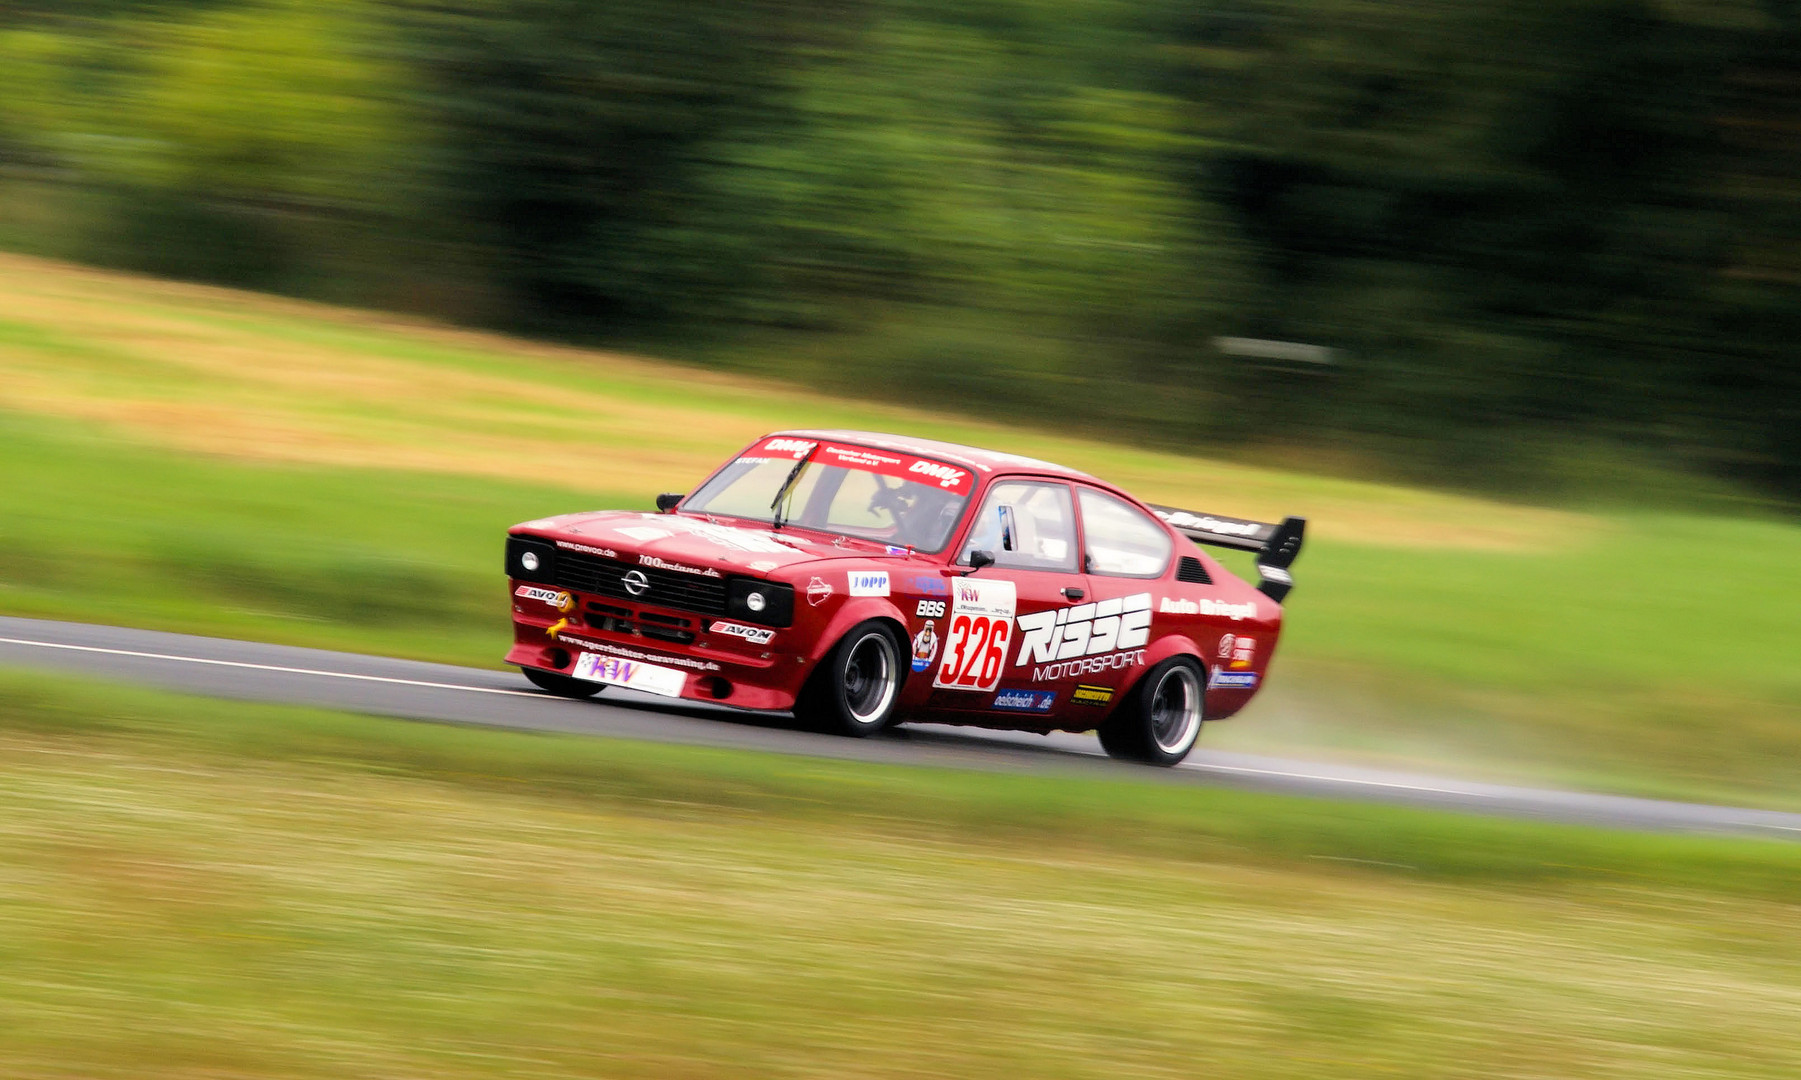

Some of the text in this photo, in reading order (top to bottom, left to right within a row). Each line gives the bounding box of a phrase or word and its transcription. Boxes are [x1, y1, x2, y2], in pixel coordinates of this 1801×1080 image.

[764, 439, 818, 452] DMV
[909, 460, 965, 480] DMV
[854, 576, 887, 588] JOPP
[916, 600, 946, 617] BBS
[1159, 597, 1199, 614] Auto
[725, 626, 771, 639] AVON
[940, 615, 1008, 688] 326
[1032, 649, 1148, 683] MOTORSPORT
